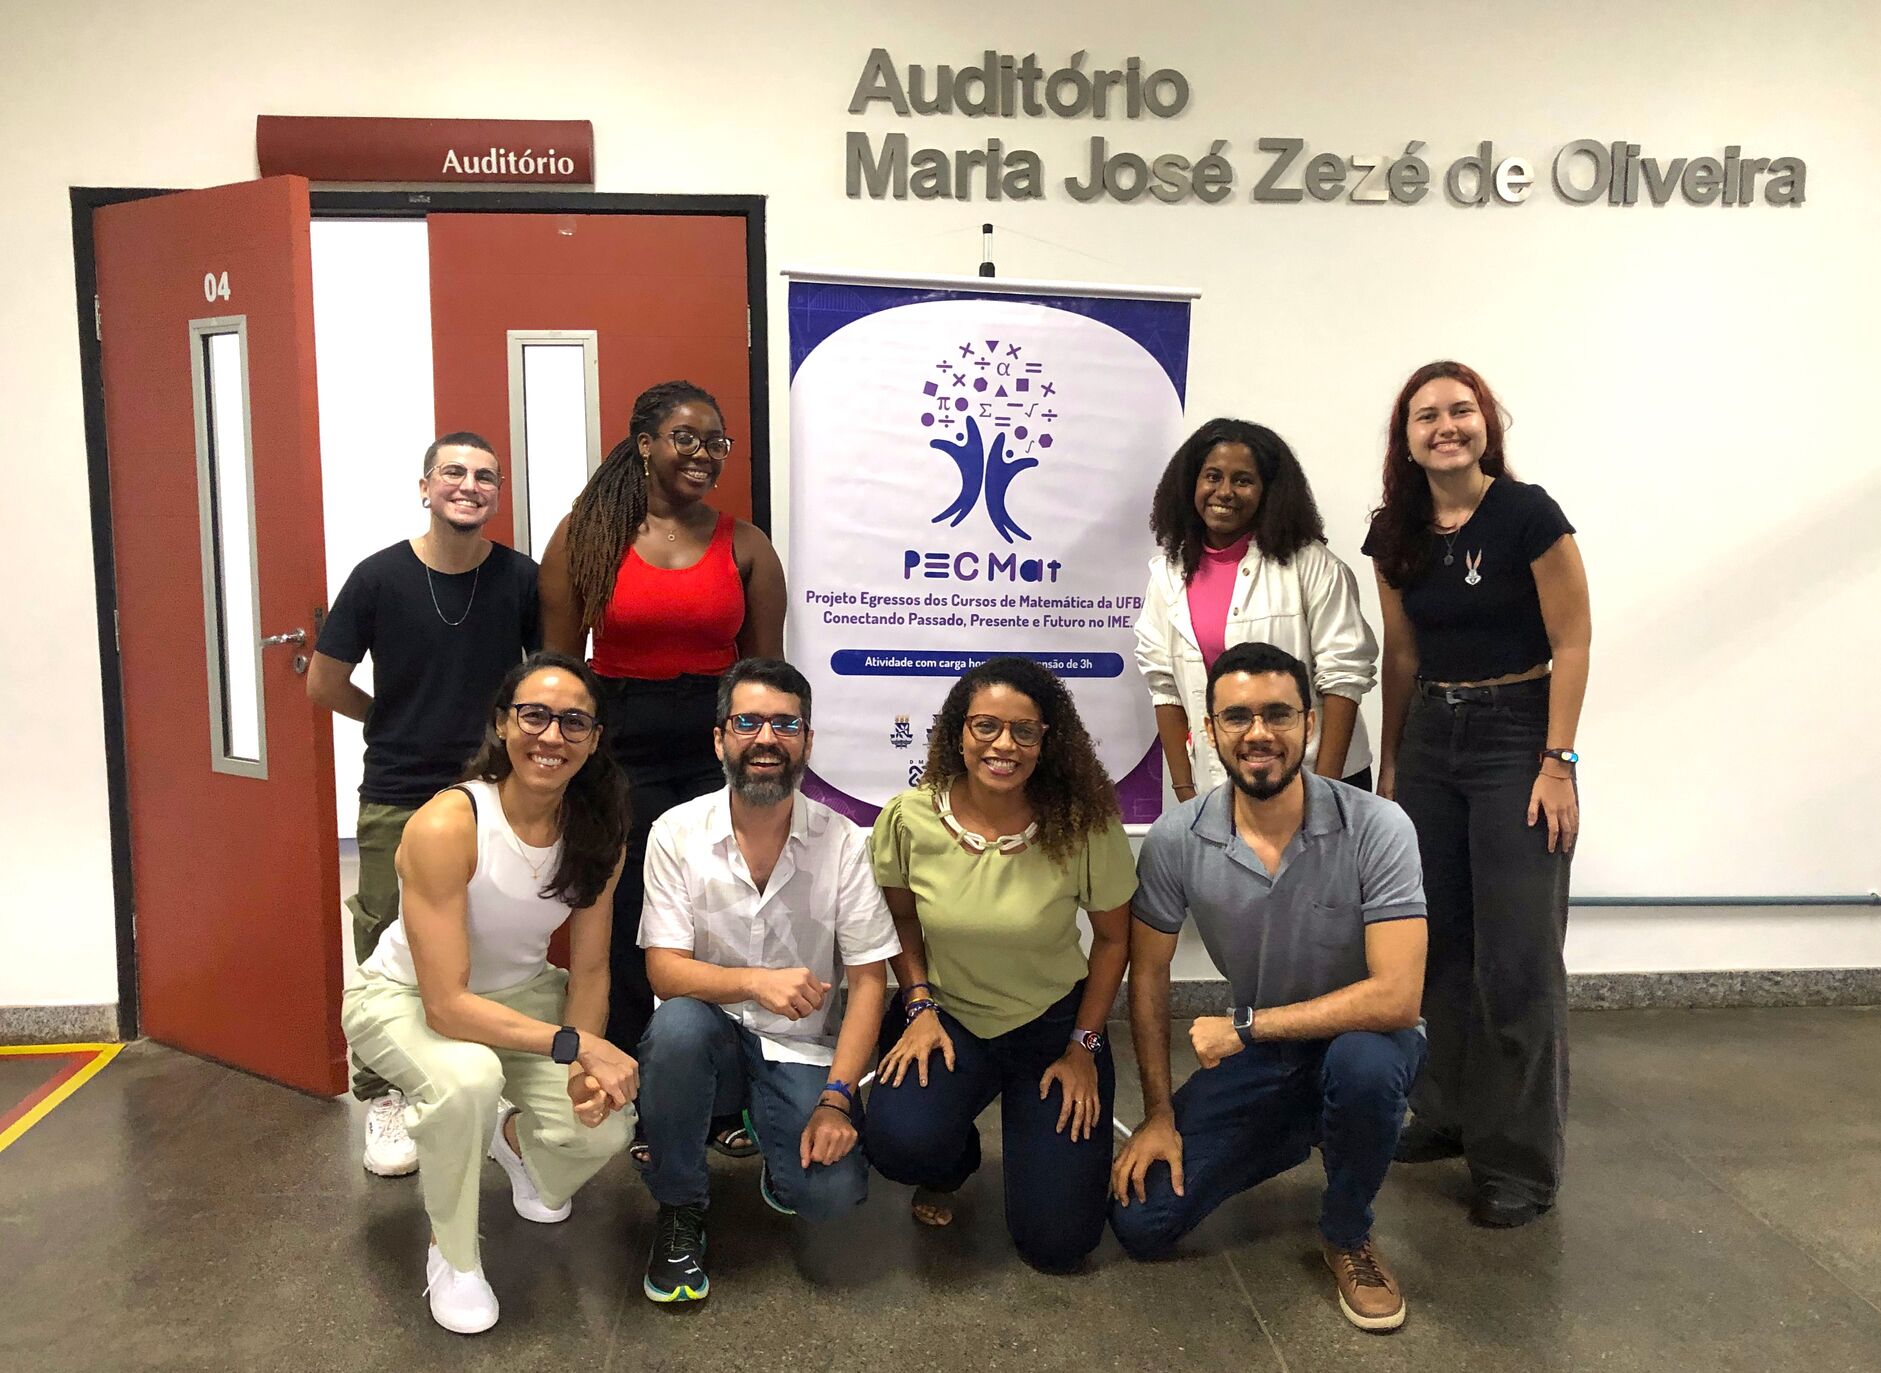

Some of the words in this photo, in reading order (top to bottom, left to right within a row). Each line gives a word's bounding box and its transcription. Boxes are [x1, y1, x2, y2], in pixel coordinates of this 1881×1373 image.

[848, 48, 1190, 118] Auditório
[442, 148, 575, 175] Auditório
[846, 131, 1044, 201] Maria
[1064, 136, 1233, 203] José
[1253, 137, 1430, 203] Zezé
[1448, 141, 1535, 205] de
[1554, 138, 1807, 207] Oliveira
[204, 271, 231, 303] 04
[904, 550, 979, 581] PEC
[988, 552, 1062, 583] Mat
[806, 590, 857, 607] Projeto
[860, 592, 921, 608] Egressos
[924, 593, 948, 607] dos
[951, 594, 997, 607] Cursos
[1000, 595, 1016, 608] de
[1019, 595, 1094, 609] Matemática
[1097, 596, 1112, 609] da
[823, 611, 905, 625] Conectando
[908, 612, 967, 628] Passado,
[970, 614, 1029, 627] Presente
[1032, 618, 1040, 628] e
[1043, 615, 1085, 628] Futuro
[1088, 618, 1104, 628] no
[1107, 615, 1133, 628] IME.
[865, 656, 913, 667] Atividade
[915, 659, 937, 667] com
[939, 660, 966, 671] carga
[1066, 659, 1078, 669] de
[1080, 659, 1093, 669] 3h
